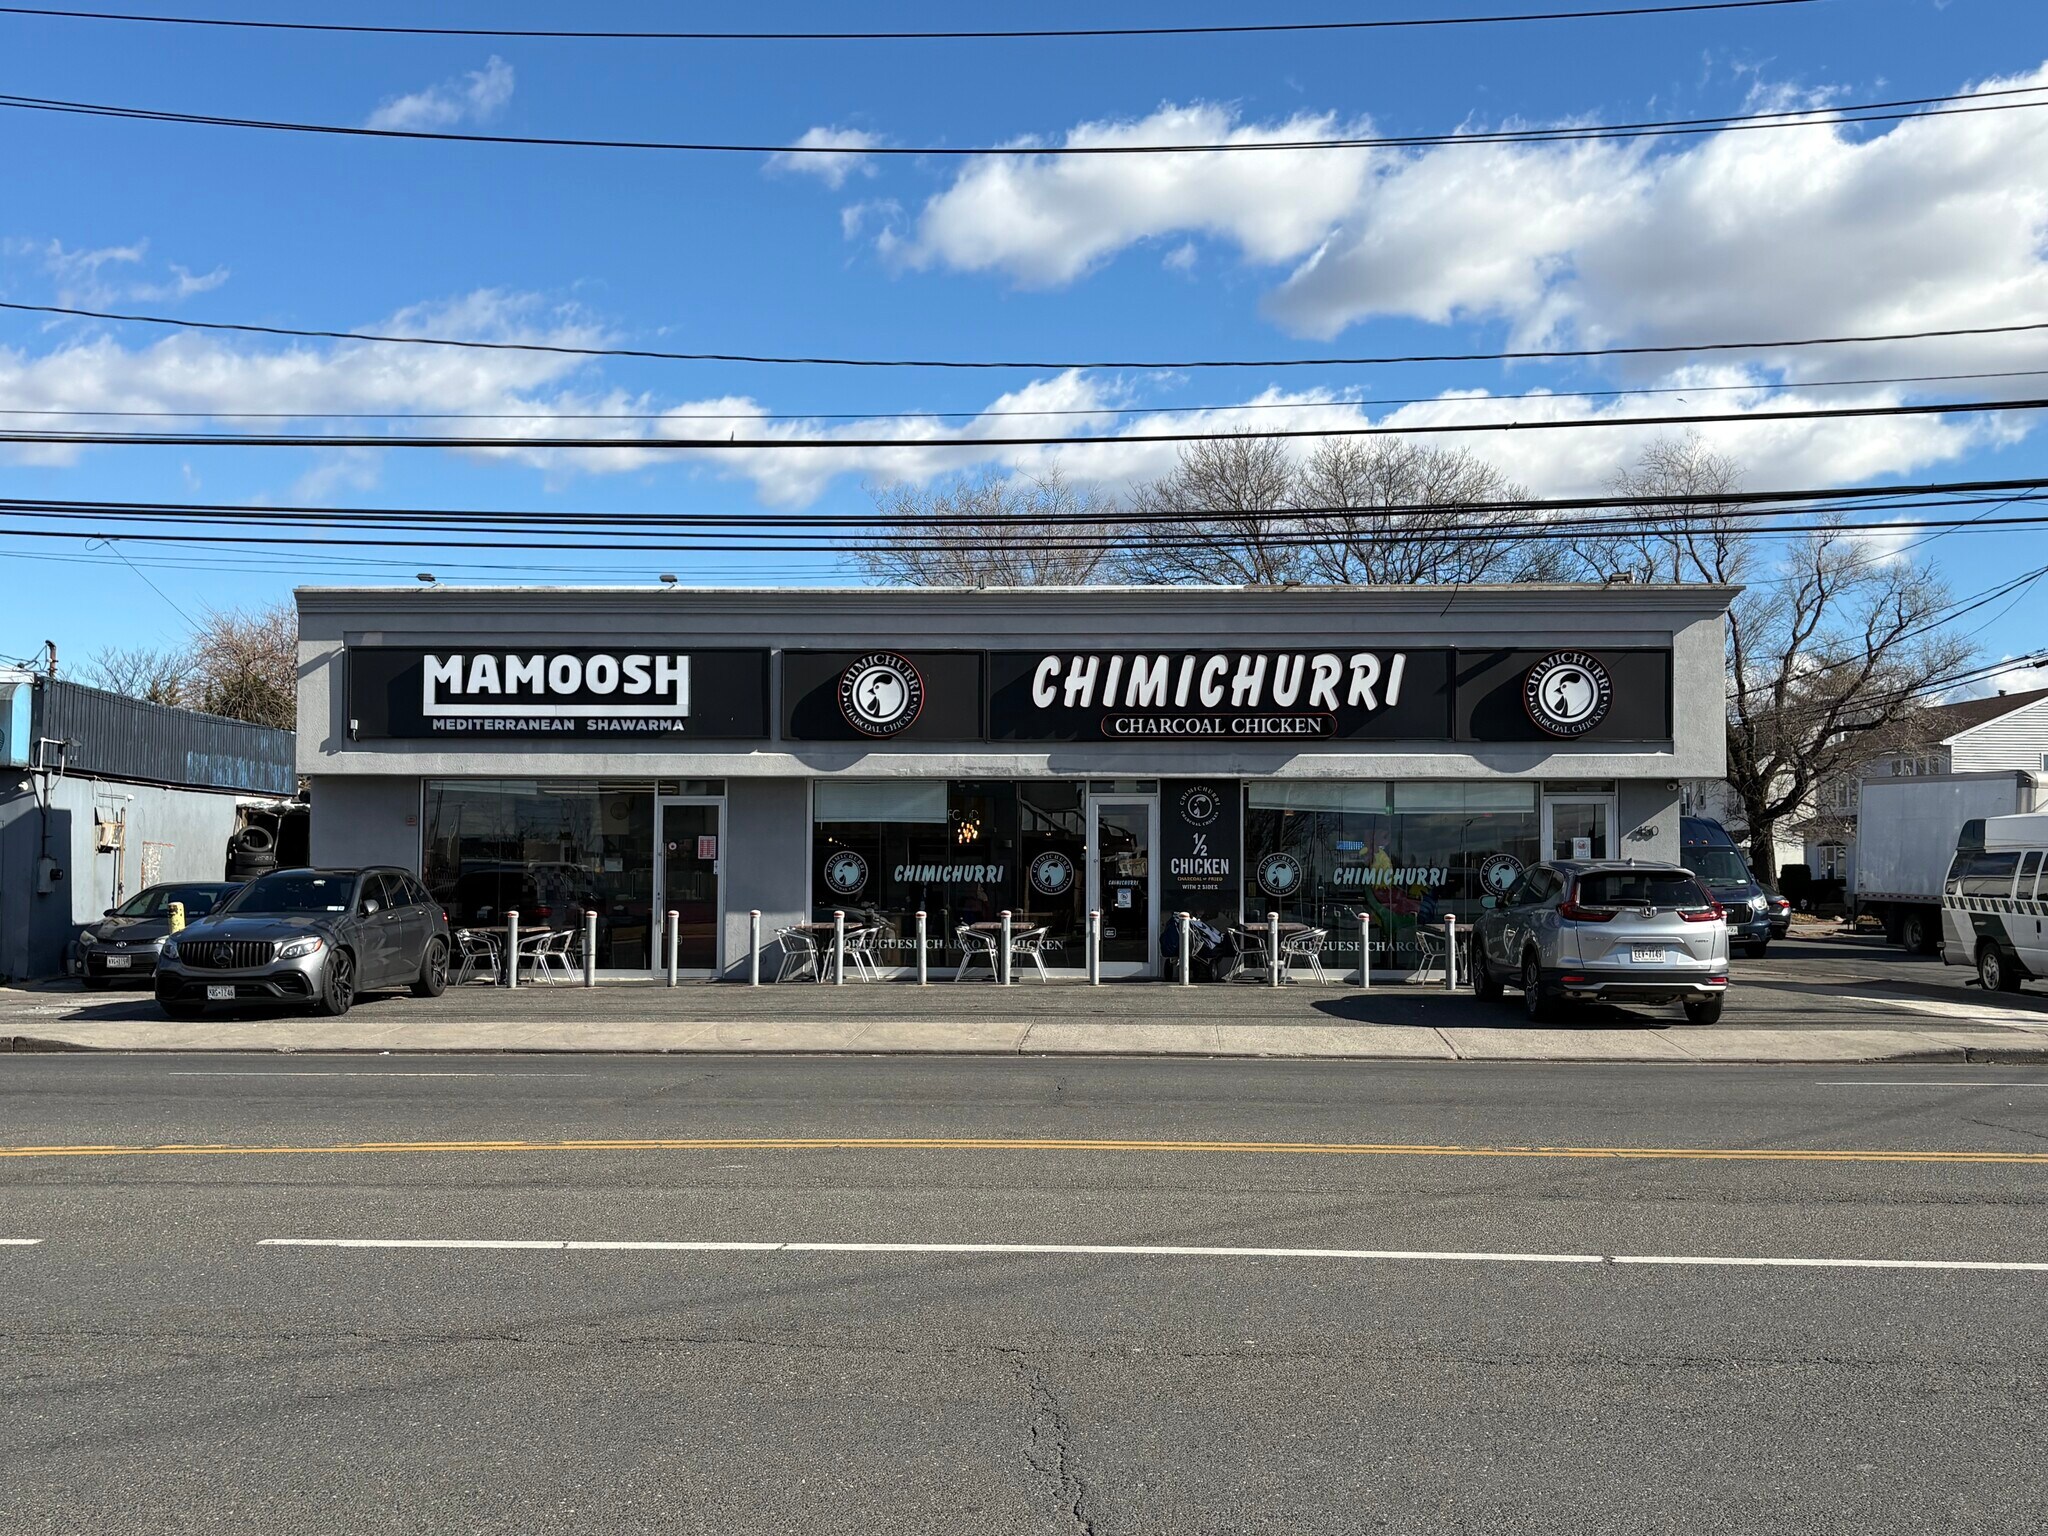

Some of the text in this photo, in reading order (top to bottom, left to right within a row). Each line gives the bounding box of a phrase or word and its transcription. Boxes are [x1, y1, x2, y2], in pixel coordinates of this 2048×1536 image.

[841, 654, 921, 696] CHIMICHURRI
[1032, 653, 1407, 711] CHIMICHURRI
[1527, 652, 1611, 696] CHIMICHURRI
[424, 654, 690, 716] MAMOOSH
[432, 718, 684, 731] MEDITERRANEAN SHAWARMA
[844, 702, 918, 733] CHARCOAL CHICKEN
[1115, 717, 1322, 734] CHARCOAL CHICKEN
[1530, 701, 1608, 733] CHARCOAL CHICKEN
[1180, 786, 1221, 806] CHIMICHURRI
[827, 853, 866, 873] CHIMICHURRI
[1032, 854, 1071, 873] CHIMICHURRI
[1170, 858, 1230, 875] CHICKEN
[1259, 855, 1300, 875] CHIMICHURRI
[1482, 856, 1523, 876] CHIMICHURR
[894, 864, 1004, 884] CHIMICHURRI
[1333, 867, 1449, 887] CHIMICHURRI
